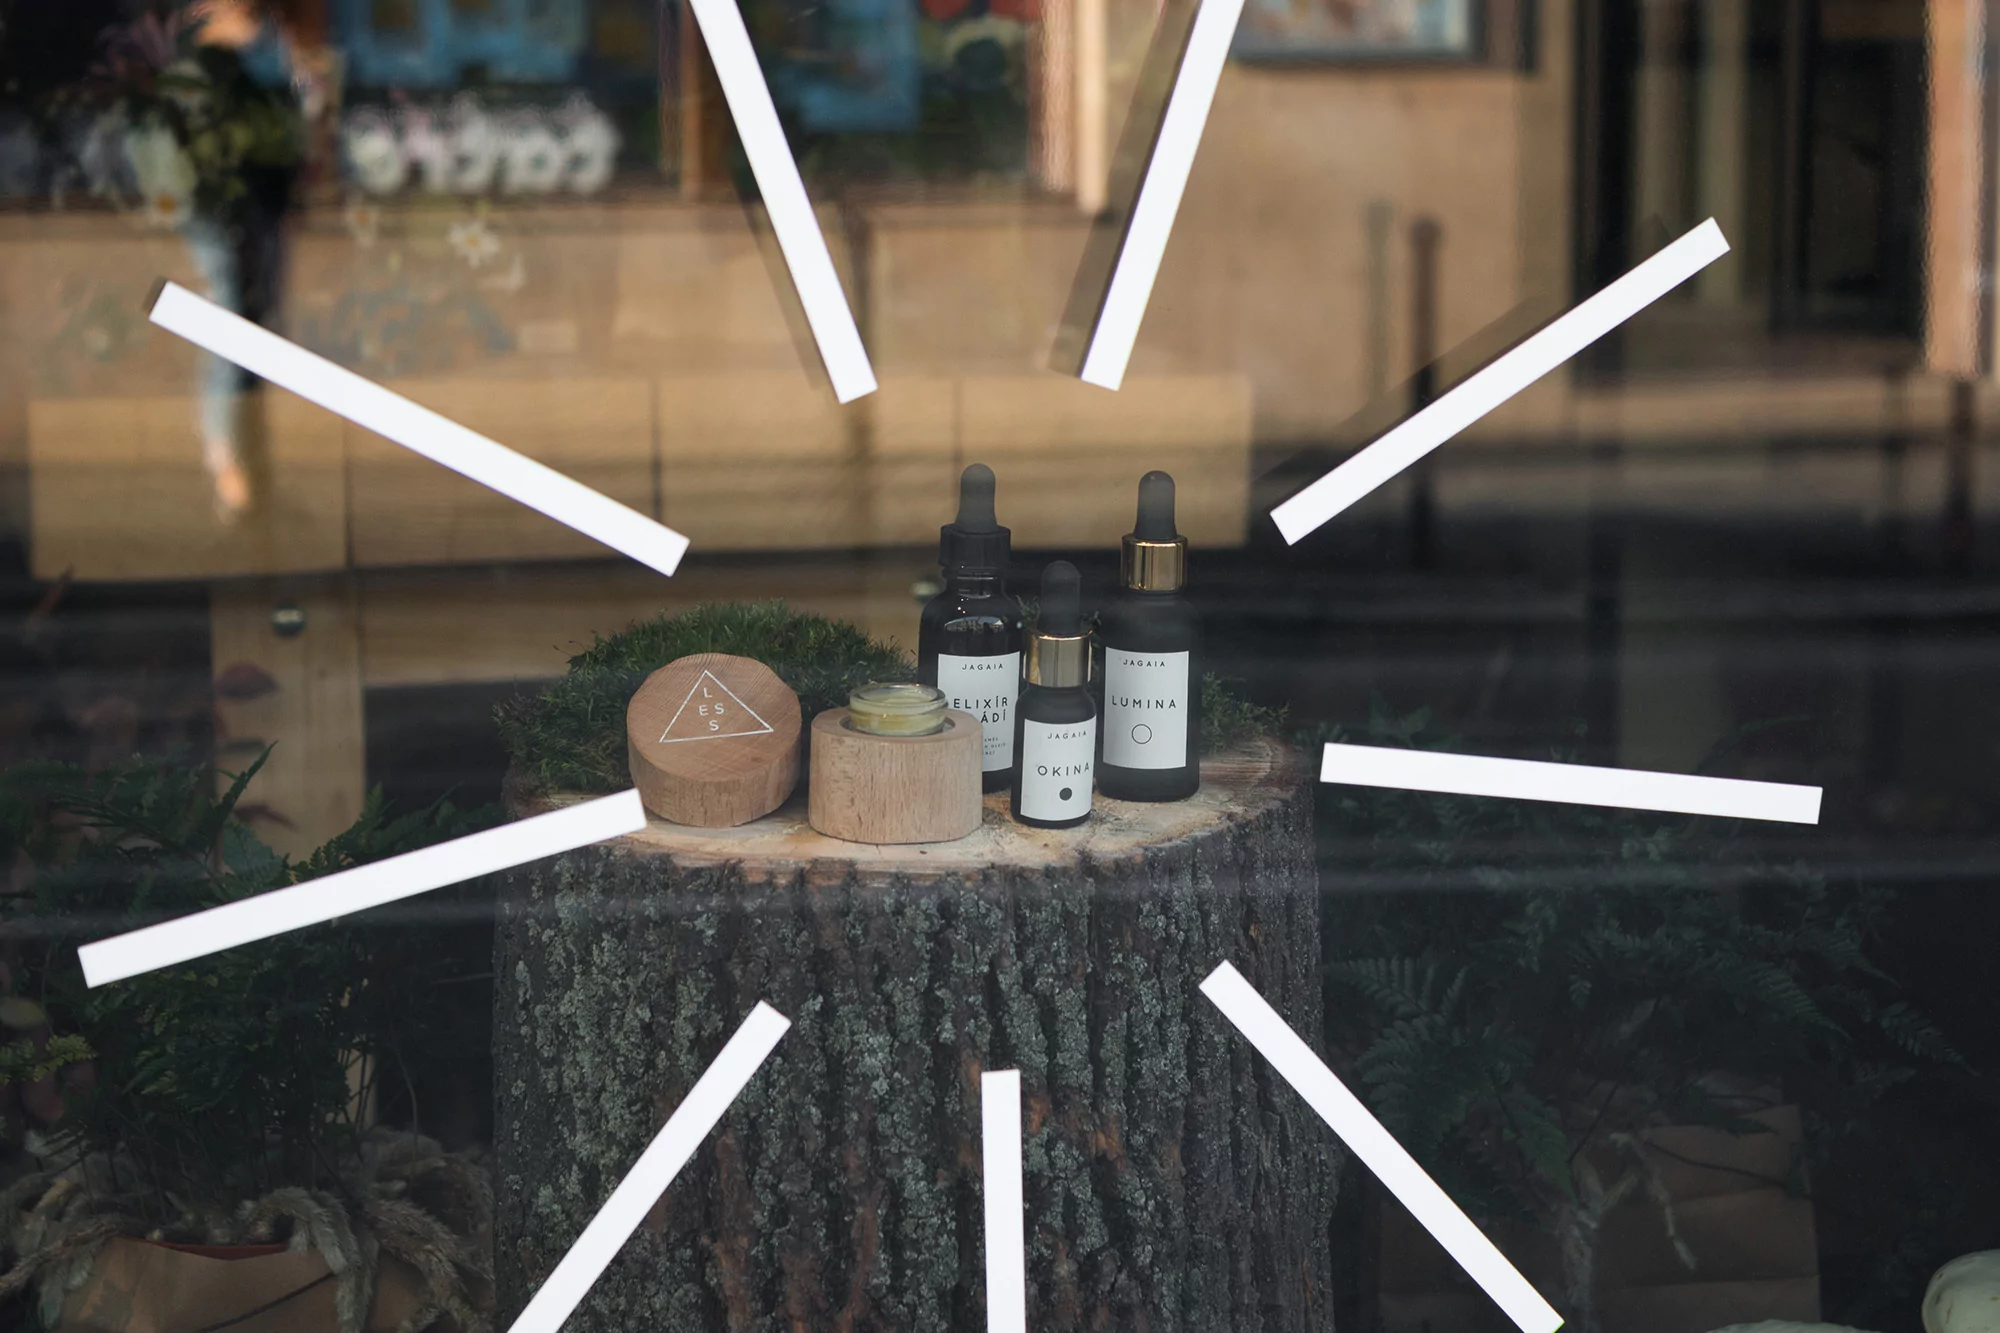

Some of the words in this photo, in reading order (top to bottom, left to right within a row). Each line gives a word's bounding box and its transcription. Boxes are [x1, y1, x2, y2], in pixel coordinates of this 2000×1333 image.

[962, 663, 1004, 671] JAGAIA
[1123, 659, 1165, 667] JAGAIA
[953, 695, 1008, 709] ELIXÍR
[1111, 695, 1176, 709] LUMINA
[980, 709, 1007, 724] ÁDÍ
[1047, 731, 1087, 740] JAGAIA
[1037, 762, 1090, 777] OKINA
